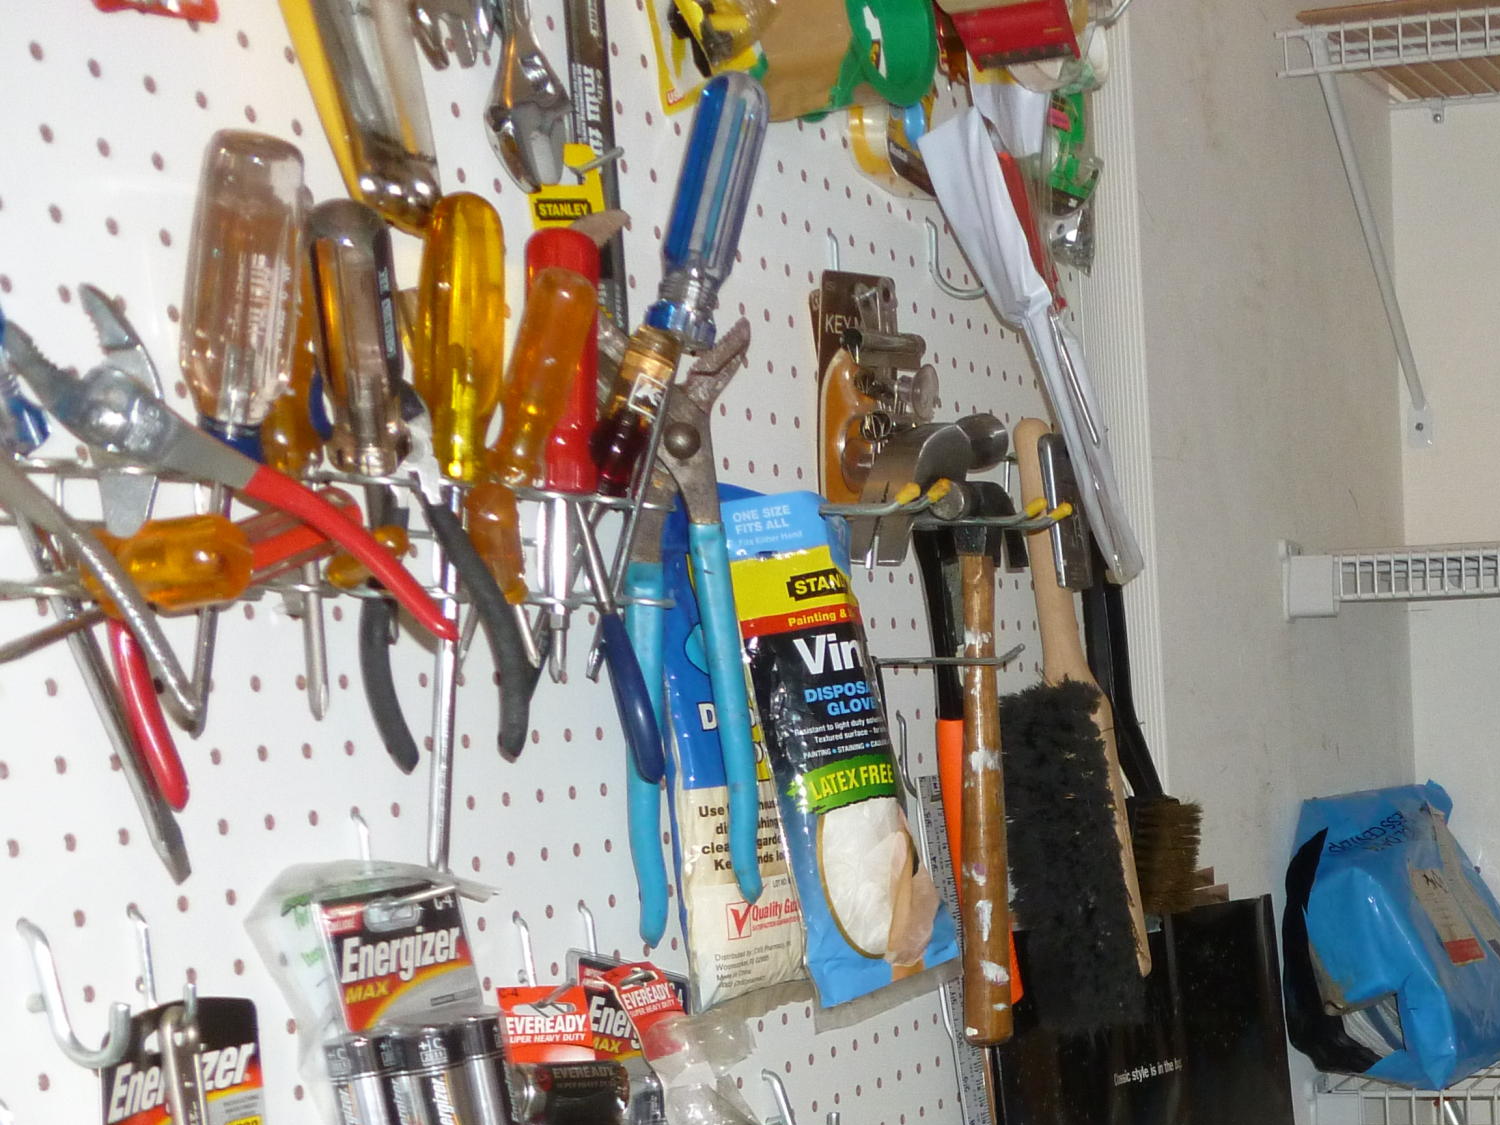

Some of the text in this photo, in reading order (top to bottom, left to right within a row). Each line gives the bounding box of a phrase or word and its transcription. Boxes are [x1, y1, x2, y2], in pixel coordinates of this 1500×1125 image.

[538, 202, 590, 218] STANLEY
[732, 503, 792, 522] ONE SIZE
[735, 518, 790, 535] FITS ALL
[794, 573, 845, 595] STAN
[787, 608, 847, 628] Painting &
[827, 723, 835, 732] to
[834, 719, 851, 733] light
[851, 717, 866, 730] duty
[814, 731, 845, 744] Textured
[803, 747, 832, 760] PAINTING
[811, 762, 895, 801] LATEX FREE
[699, 804, 725, 818] Use
[752, 901, 783, 922] Quality
[341, 925, 461, 983] Energizer
[346, 980, 391, 1005] MAX
[620, 986, 672, 1011] EVEREADY
[662, 1000, 676, 1010] DUTY
[505, 1013, 588, 1036] EVEREADY
[533, 1033, 562, 1043] HEAVY
[562, 1032, 586, 1042] DUTY
[1131, 1065, 1150, 1083] style
[1149, 1063, 1158, 1077] is
[1157, 1061, 1165, 1075] in
[1164, 1059, 1175, 1073] the
[107, 1042, 256, 1125] Enerzer
